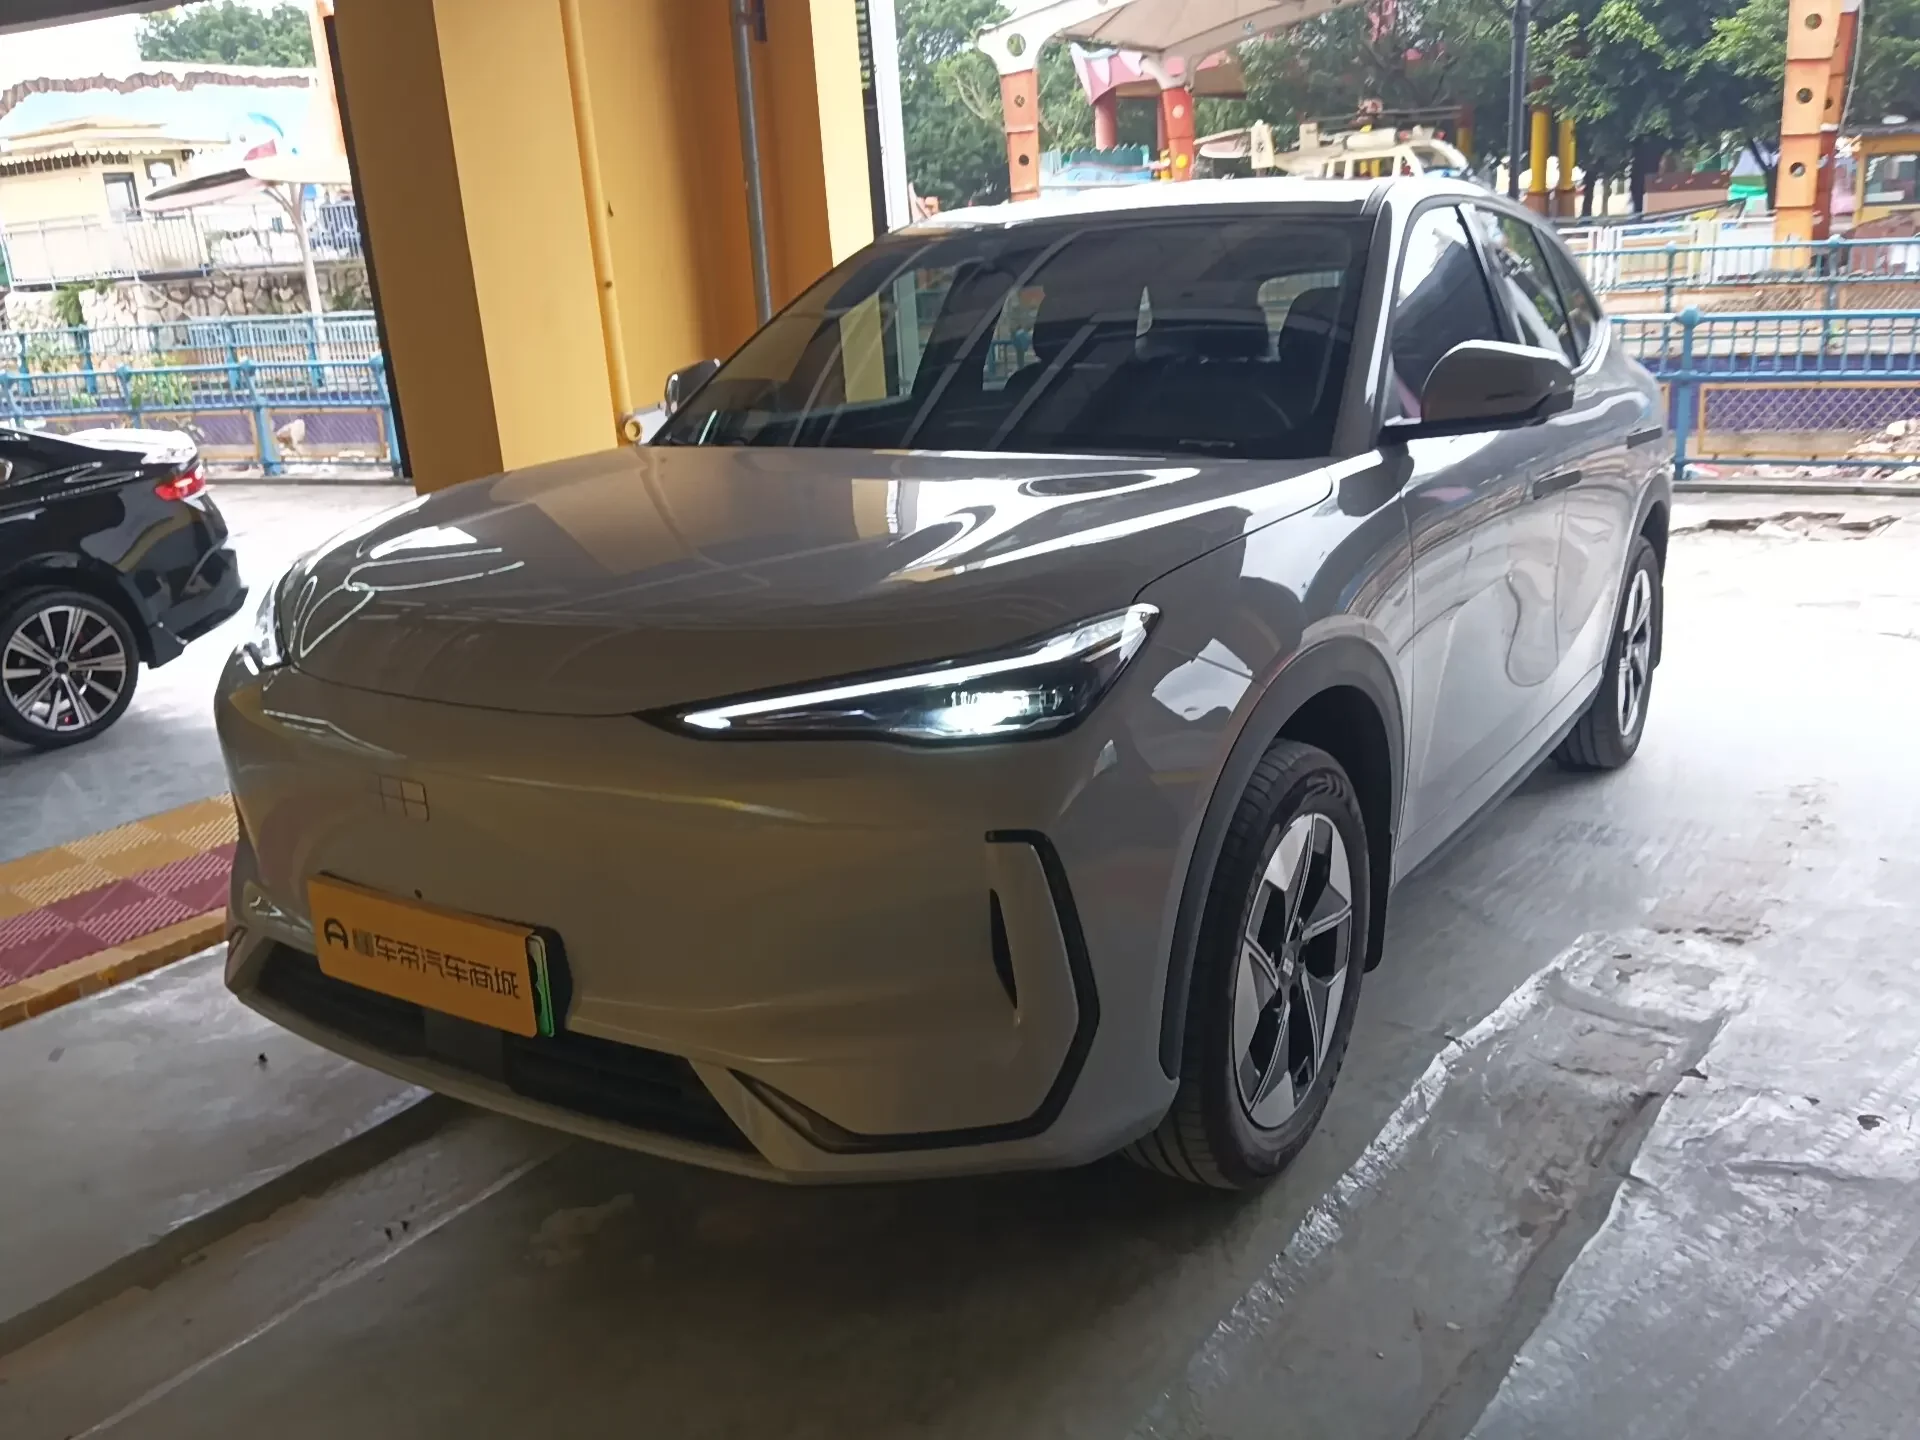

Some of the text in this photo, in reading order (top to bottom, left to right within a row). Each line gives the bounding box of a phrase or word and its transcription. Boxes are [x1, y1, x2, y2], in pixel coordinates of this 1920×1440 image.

[354, 929, 520, 999] 车帝汽车商城
